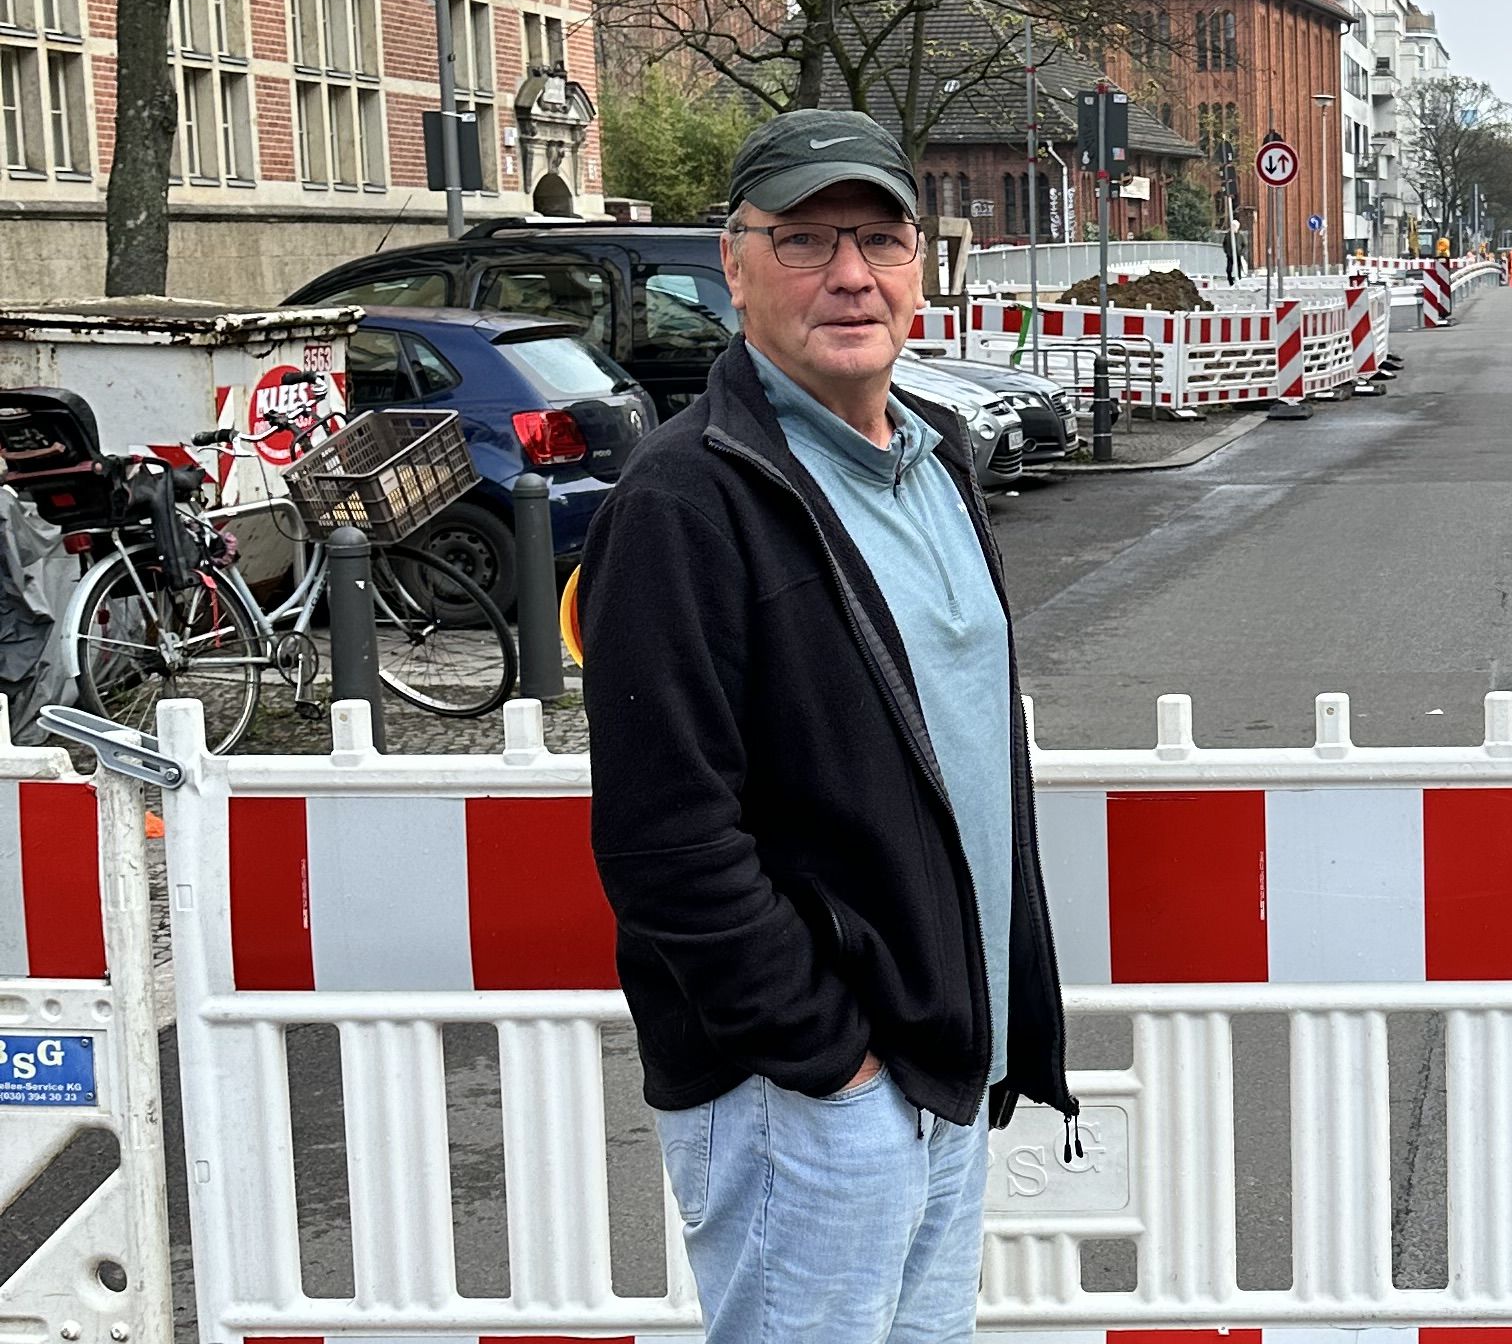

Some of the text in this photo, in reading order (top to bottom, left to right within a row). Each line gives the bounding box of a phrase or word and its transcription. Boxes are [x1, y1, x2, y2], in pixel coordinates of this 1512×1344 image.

[304, 347, 331, 372] 3563
[256, 382, 309, 418] KLEES
[28, 1093, 46, 1101] 394
[66, 1083, 82, 1091] KG
[988, 1122, 1106, 1197] SG
